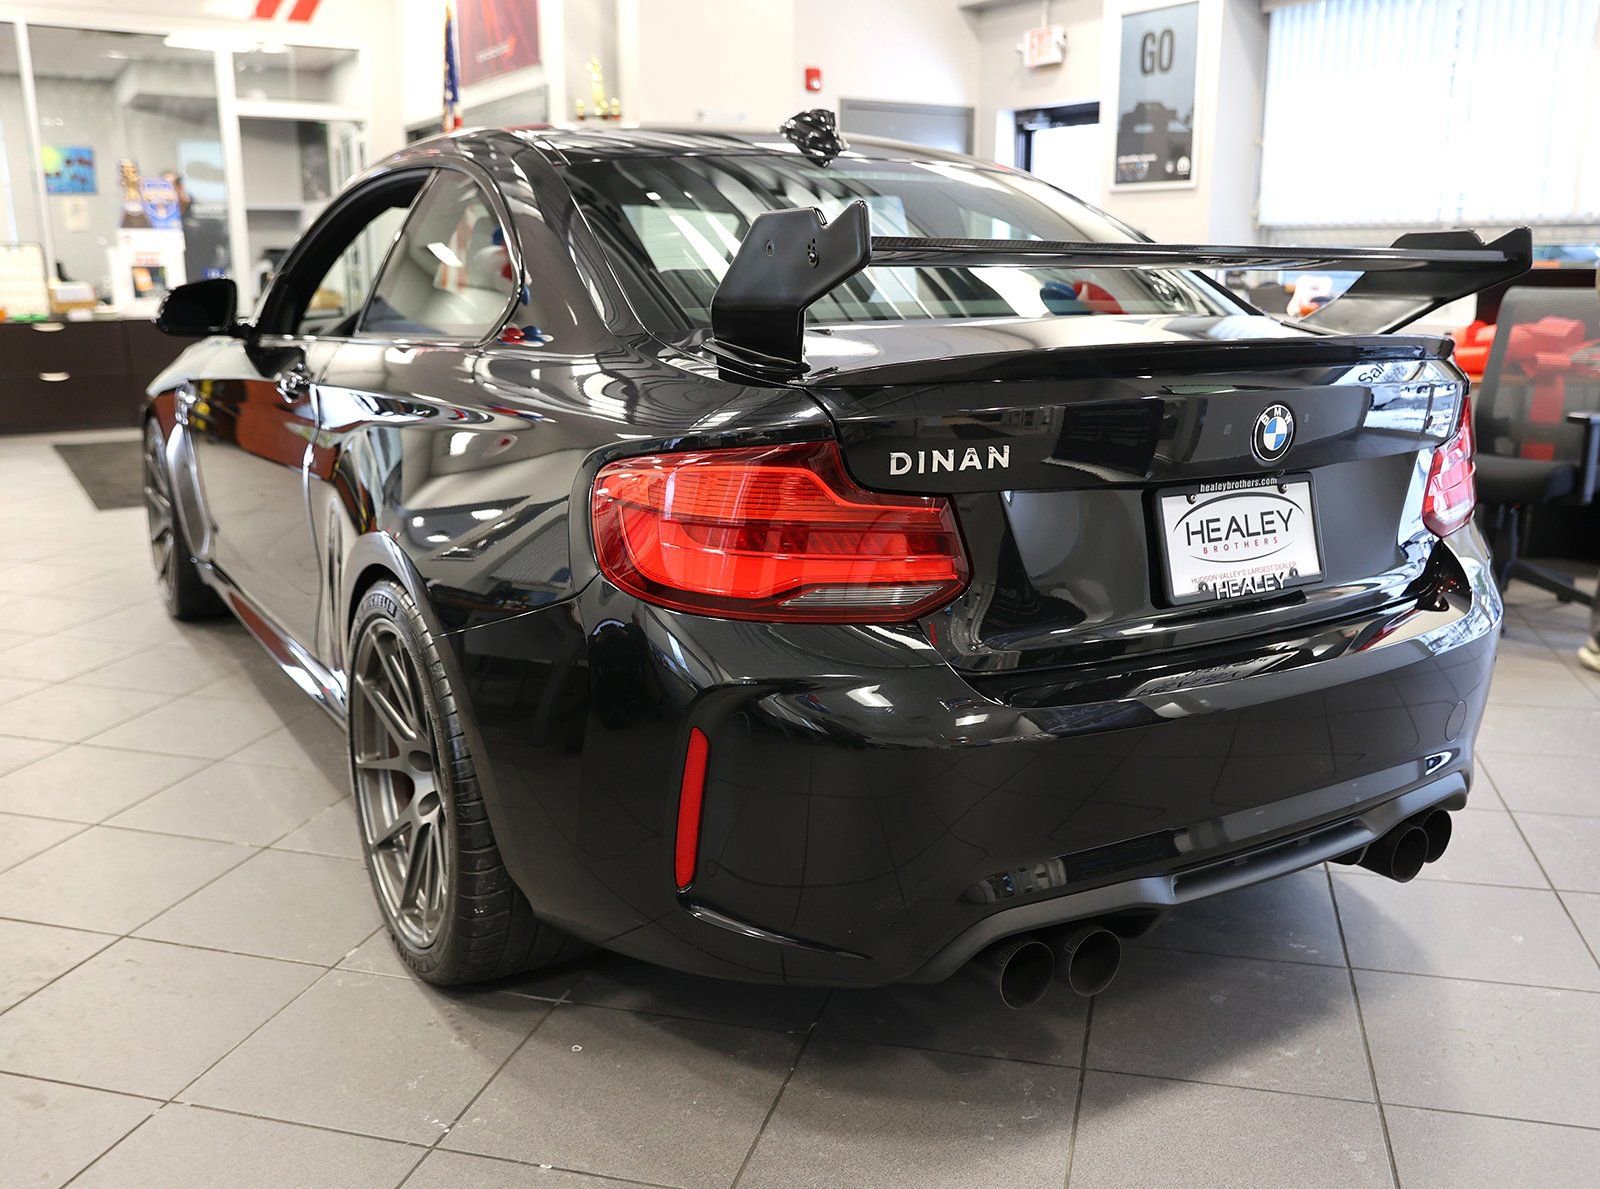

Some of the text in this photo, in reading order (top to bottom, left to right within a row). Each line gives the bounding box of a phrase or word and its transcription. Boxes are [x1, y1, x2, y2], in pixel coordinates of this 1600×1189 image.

[1140, 29, 1175, 75] GO
[1260, 407, 1292, 425] BMW
[889, 445, 1010, 475] DINAN
[1200, 477, 1278, 493] healeybrothers.com
[1186, 508, 1293, 546] HEALEY
[1203, 536, 1278, 554] BROTHERS
[1191, 561, 1297, 584] HUDSON VALLEY'S LARGEST DEALER
[1214, 571, 1285, 599] HEALEY
